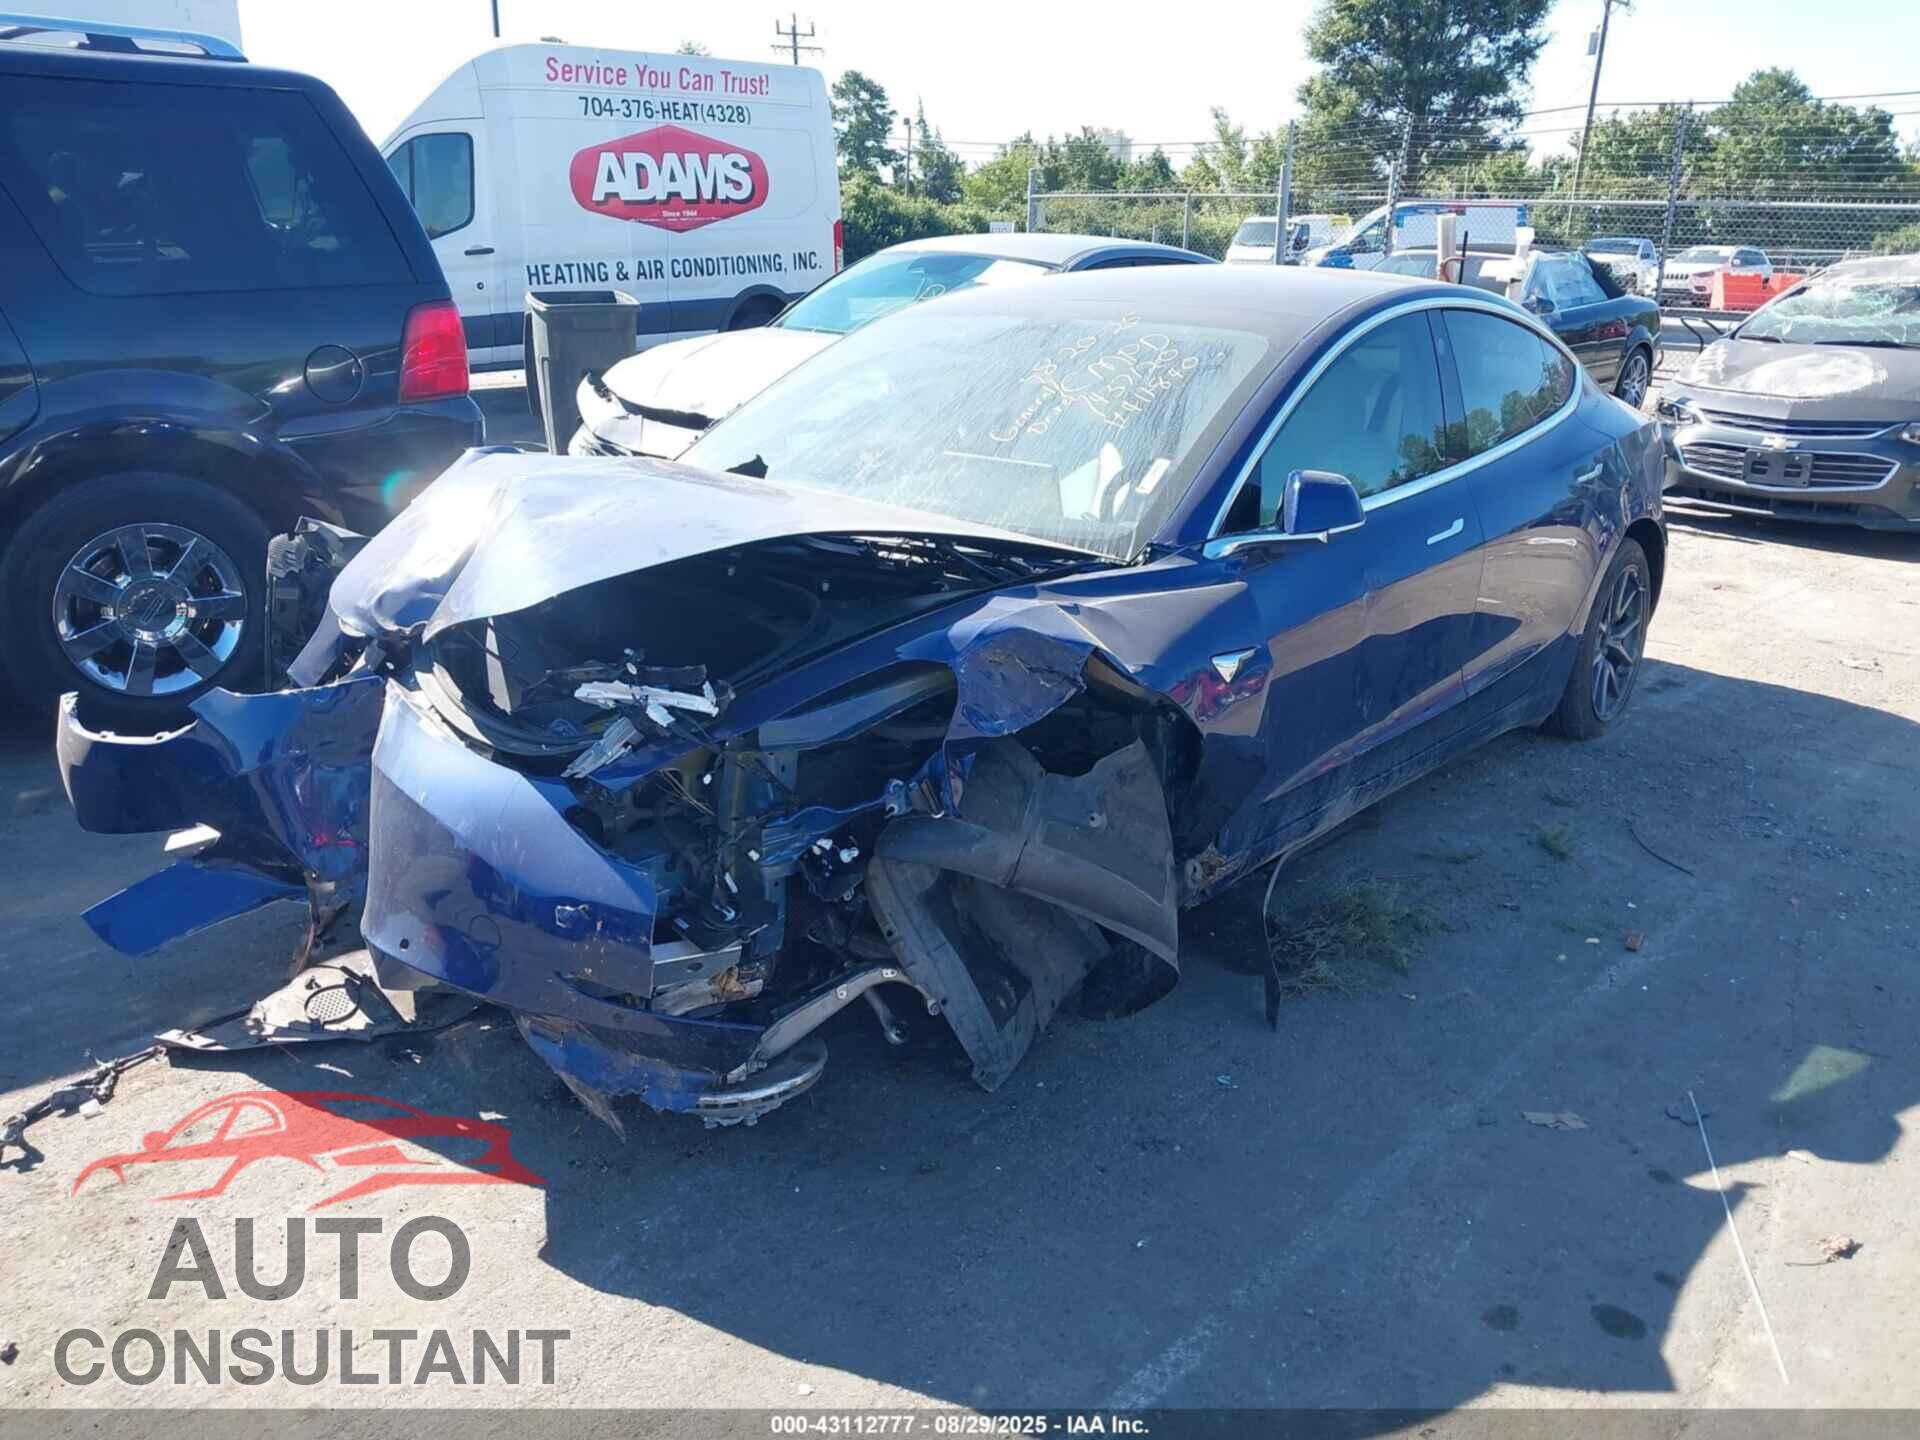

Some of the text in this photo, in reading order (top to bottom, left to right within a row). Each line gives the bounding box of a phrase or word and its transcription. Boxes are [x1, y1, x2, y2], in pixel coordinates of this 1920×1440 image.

[545, 56, 770, 96] Service You Can Trust!
[578, 96, 751, 125] 704-376-HEAT(4328)
[592, 151, 756, 206] ADAMS
[662, 210, 680, 218] Since
[526, 250, 822, 287] HEATING & AIR CONDITIONING, INC.
